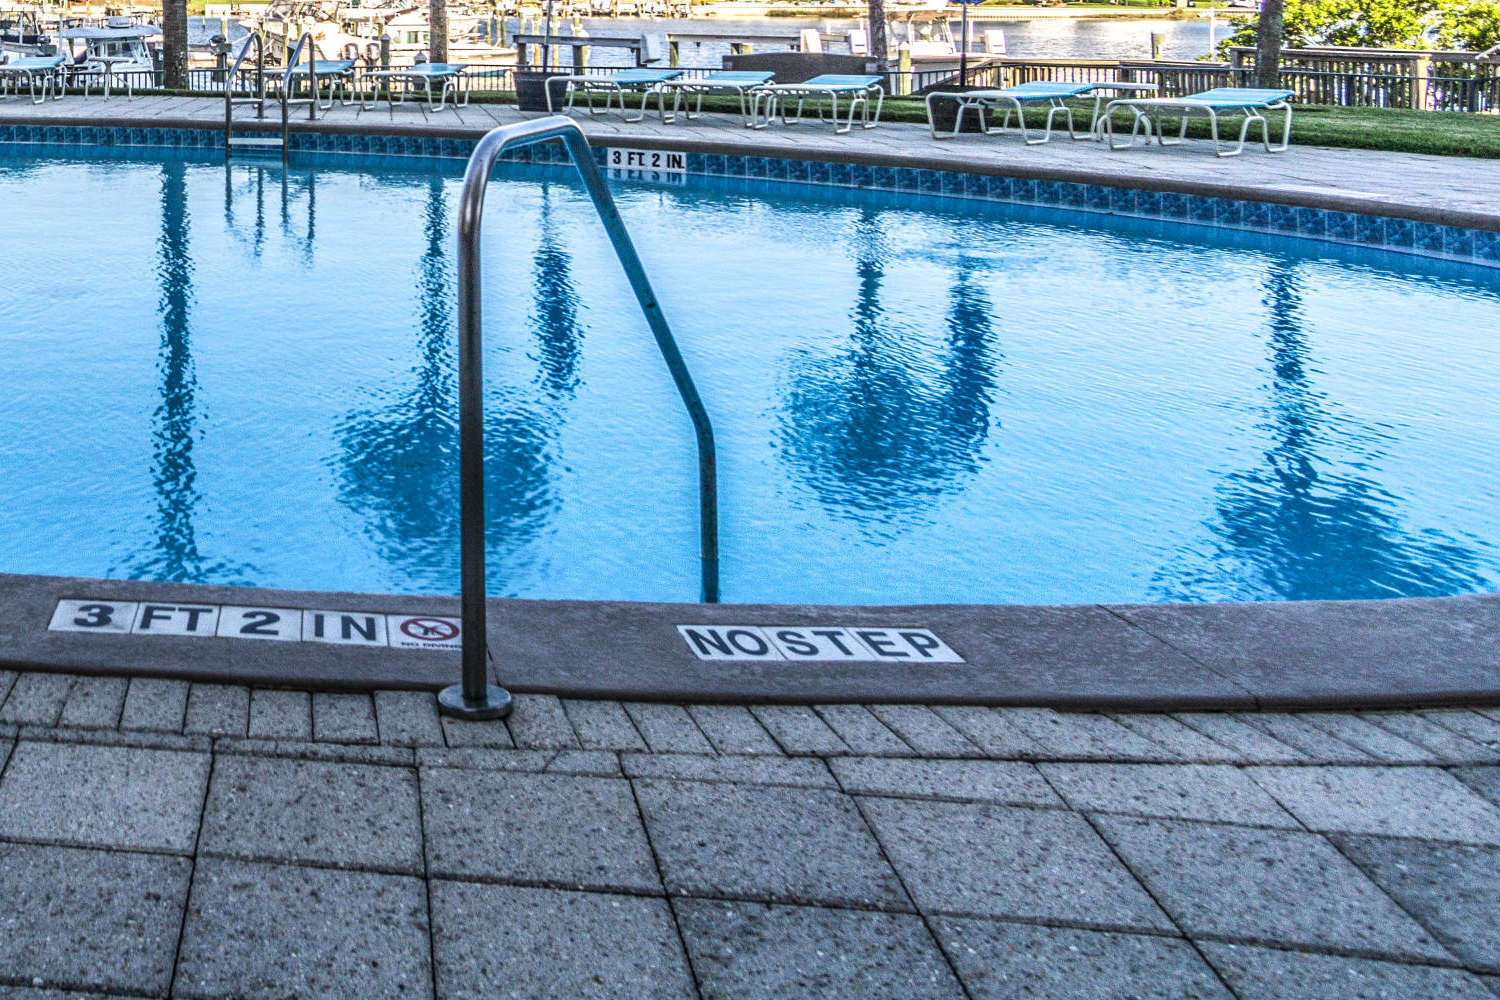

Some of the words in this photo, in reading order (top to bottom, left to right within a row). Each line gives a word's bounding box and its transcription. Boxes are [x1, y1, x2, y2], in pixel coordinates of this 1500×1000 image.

[613, 151, 621, 164] 3
[651, 153, 660, 167] 2
[74, 604, 114, 628] 3
[141, 606, 213, 631] FT
[239, 611, 280, 636] 2
[314, 614, 376, 641] IN
